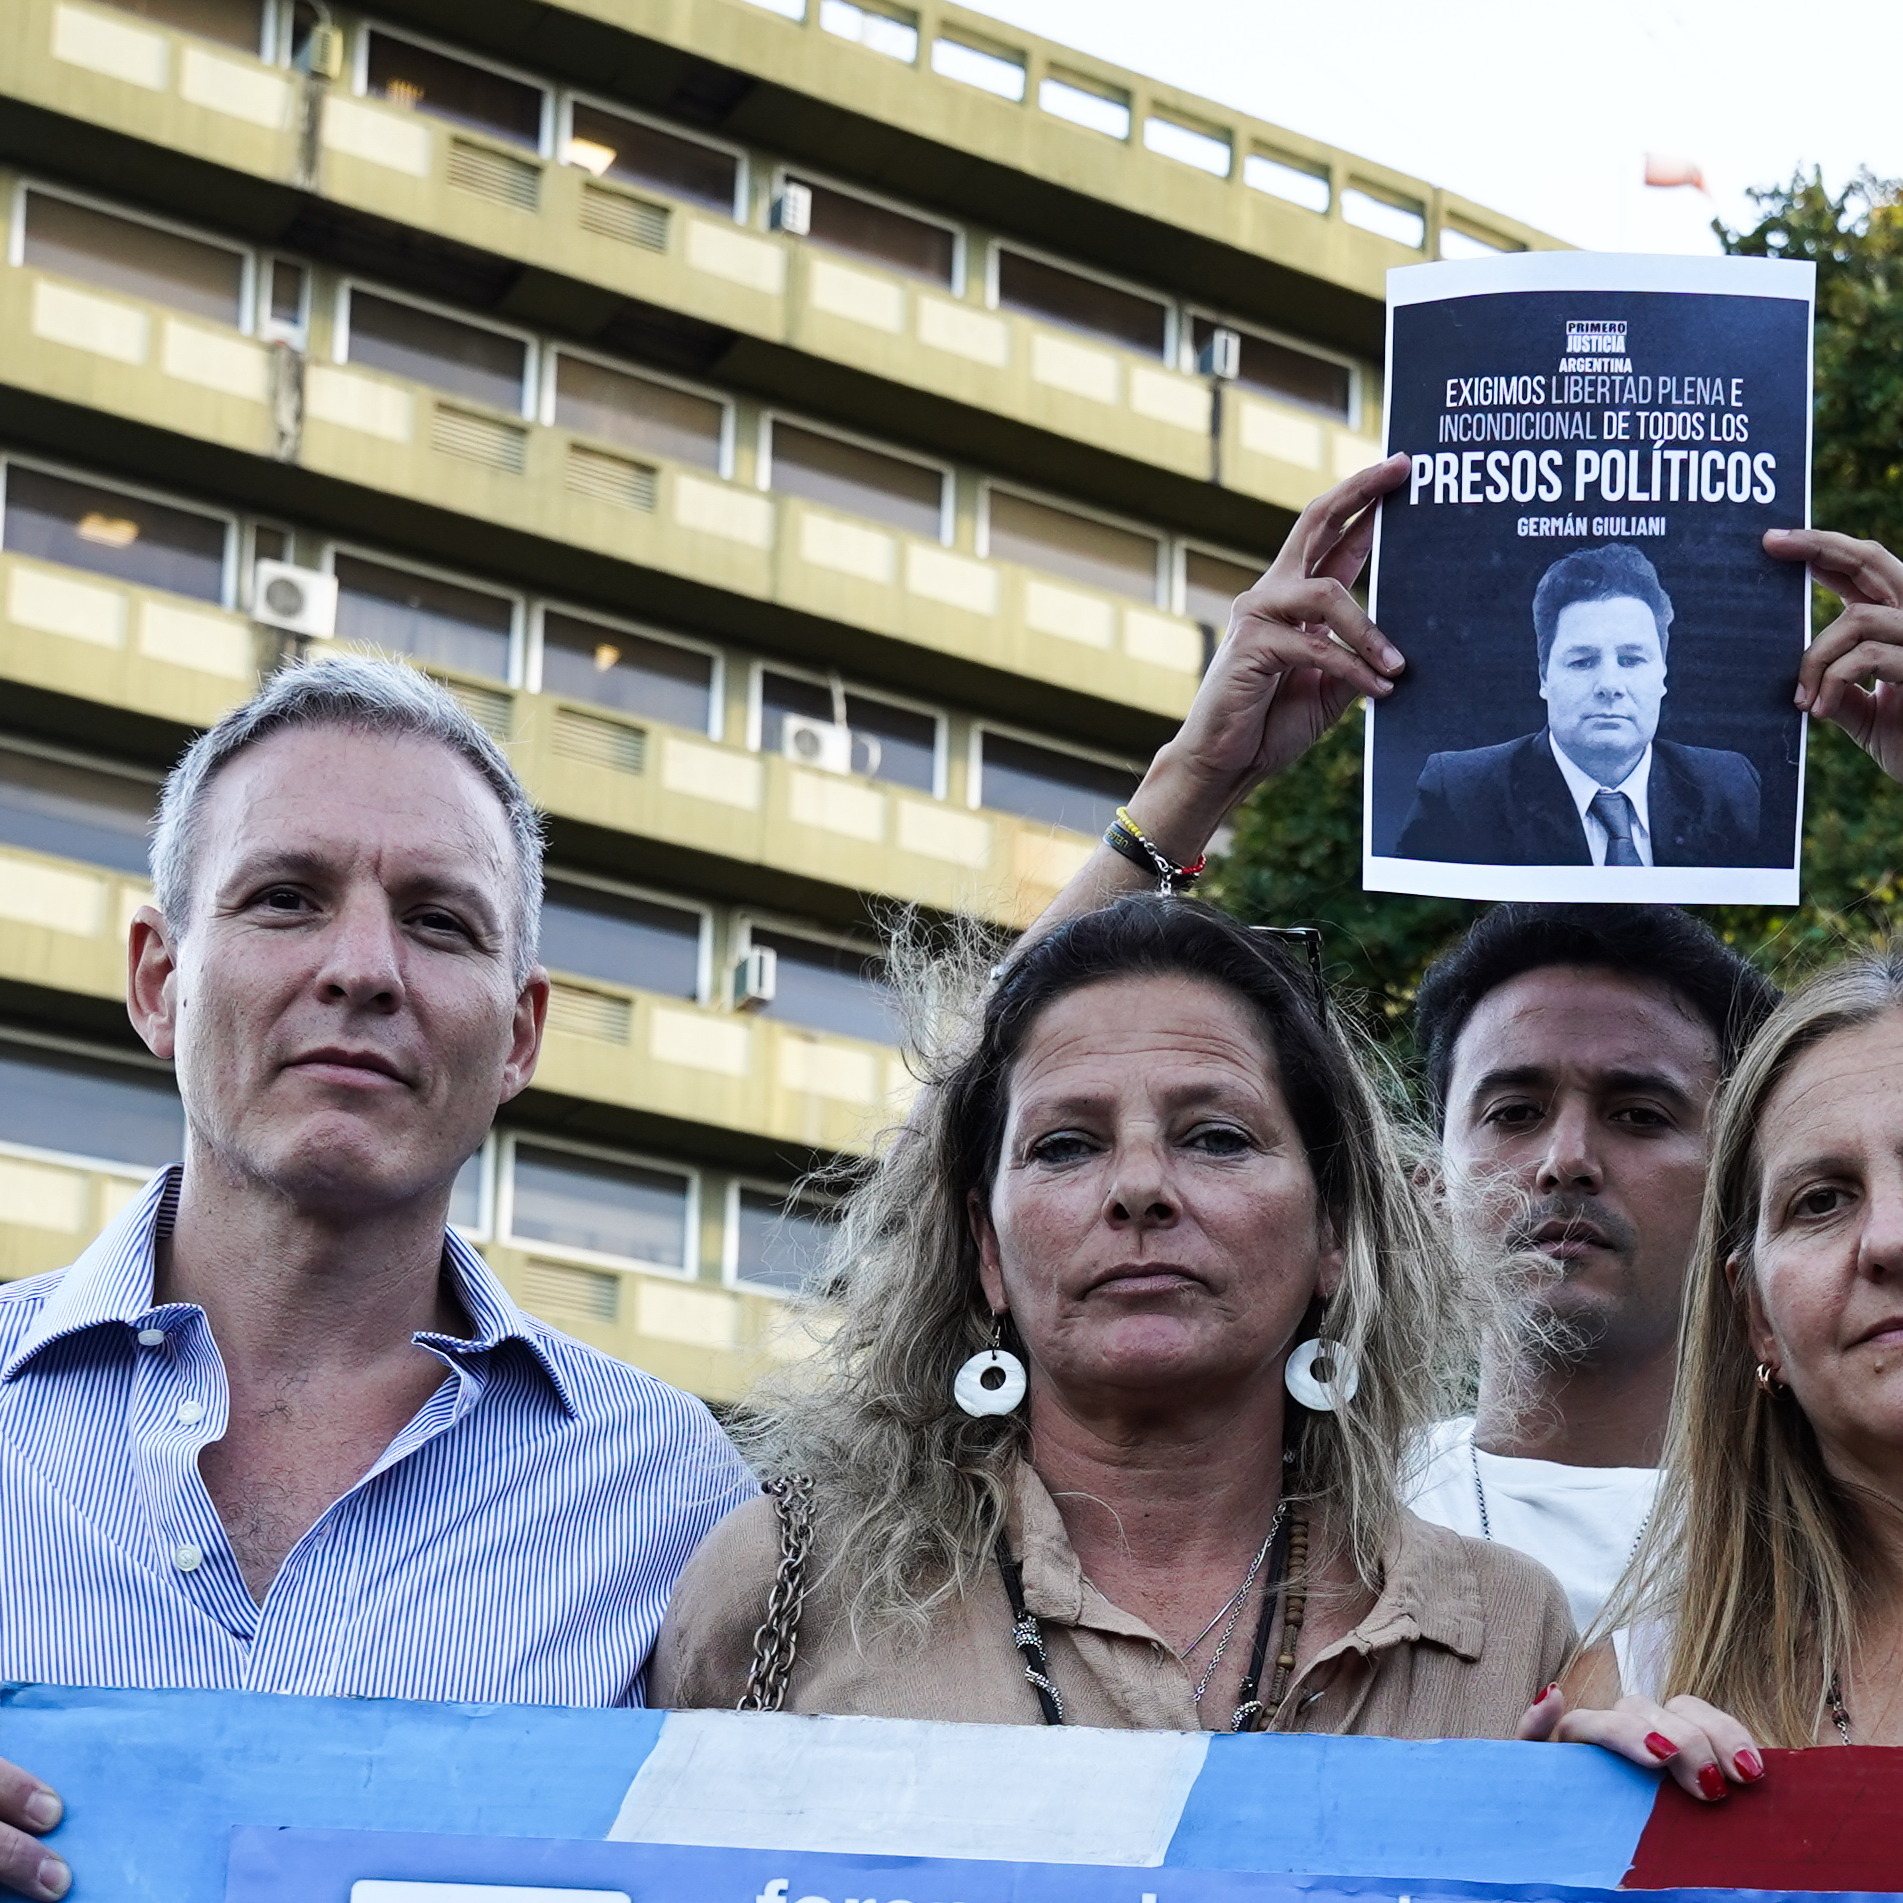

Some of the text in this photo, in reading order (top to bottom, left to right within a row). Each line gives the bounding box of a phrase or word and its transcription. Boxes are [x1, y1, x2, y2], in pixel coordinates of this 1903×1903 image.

[1568, 323, 1626, 333] PRIMERO
[1566, 335, 1625, 353] JUSTICIA
[1559, 358, 1632, 373] ARGENTINA
[1446, 375, 1743, 408] EXIGIMOS LIBERTAD PLENA E
[1439, 411, 1749, 443] INCONDICIONAL DE TODOS LOS
[1410, 441, 1776, 505] PRESOS POLÍTICOS
[1517, 512, 1665, 536] GERMÁN GIULIANI
